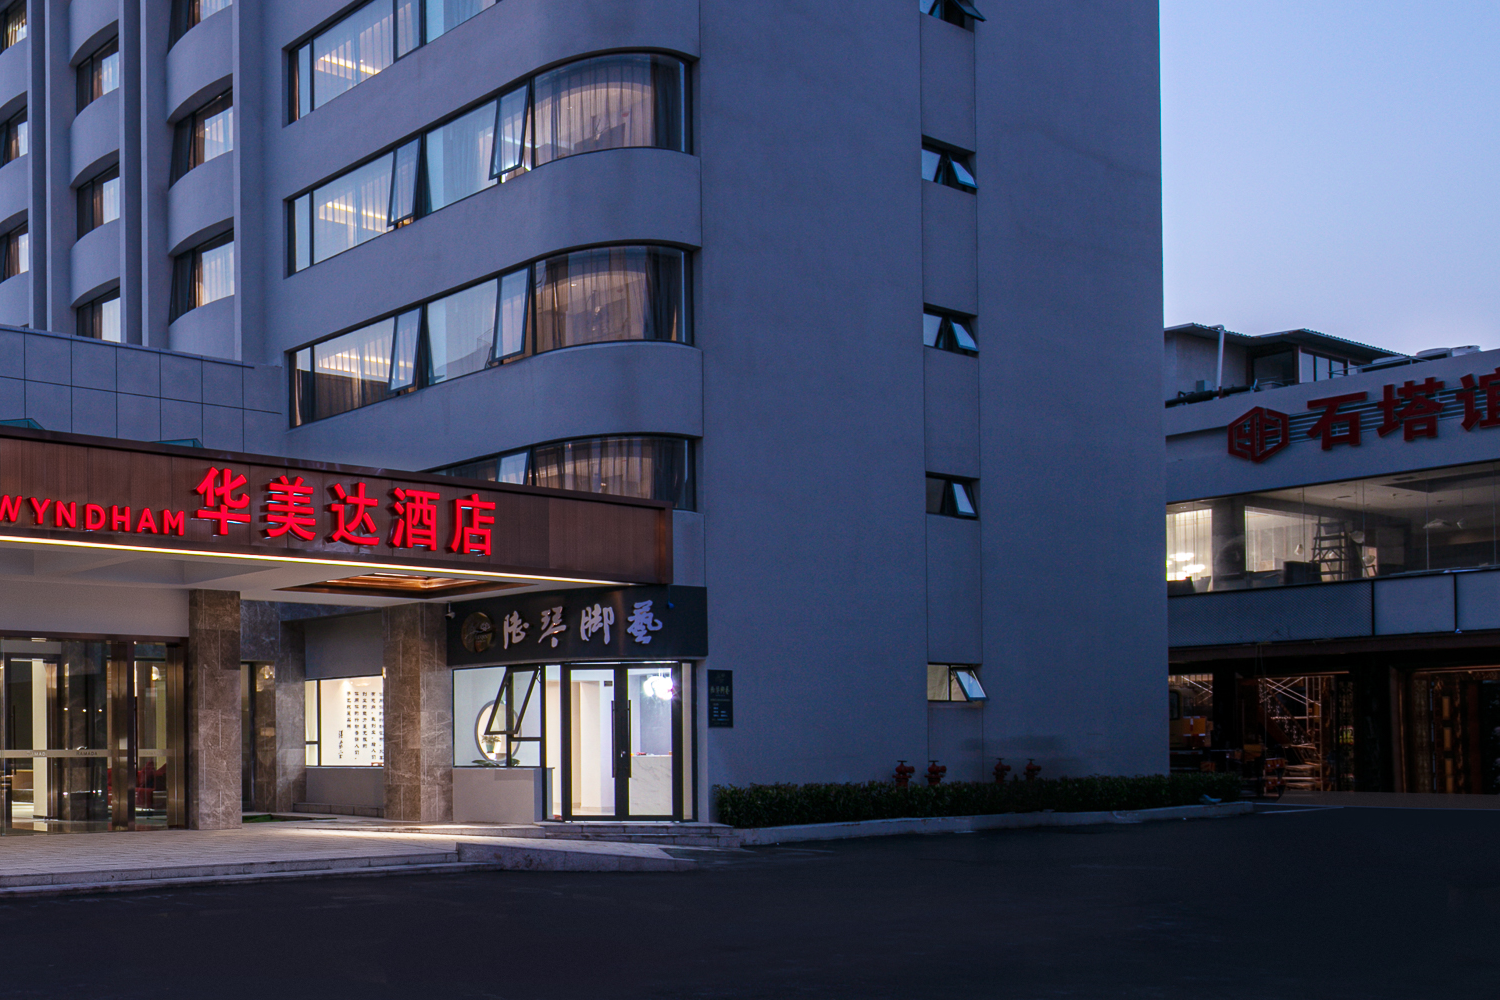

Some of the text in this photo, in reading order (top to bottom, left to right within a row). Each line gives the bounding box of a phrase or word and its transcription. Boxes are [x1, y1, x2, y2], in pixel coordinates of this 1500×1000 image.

[195, 467, 496, 556] 华美达酒店
